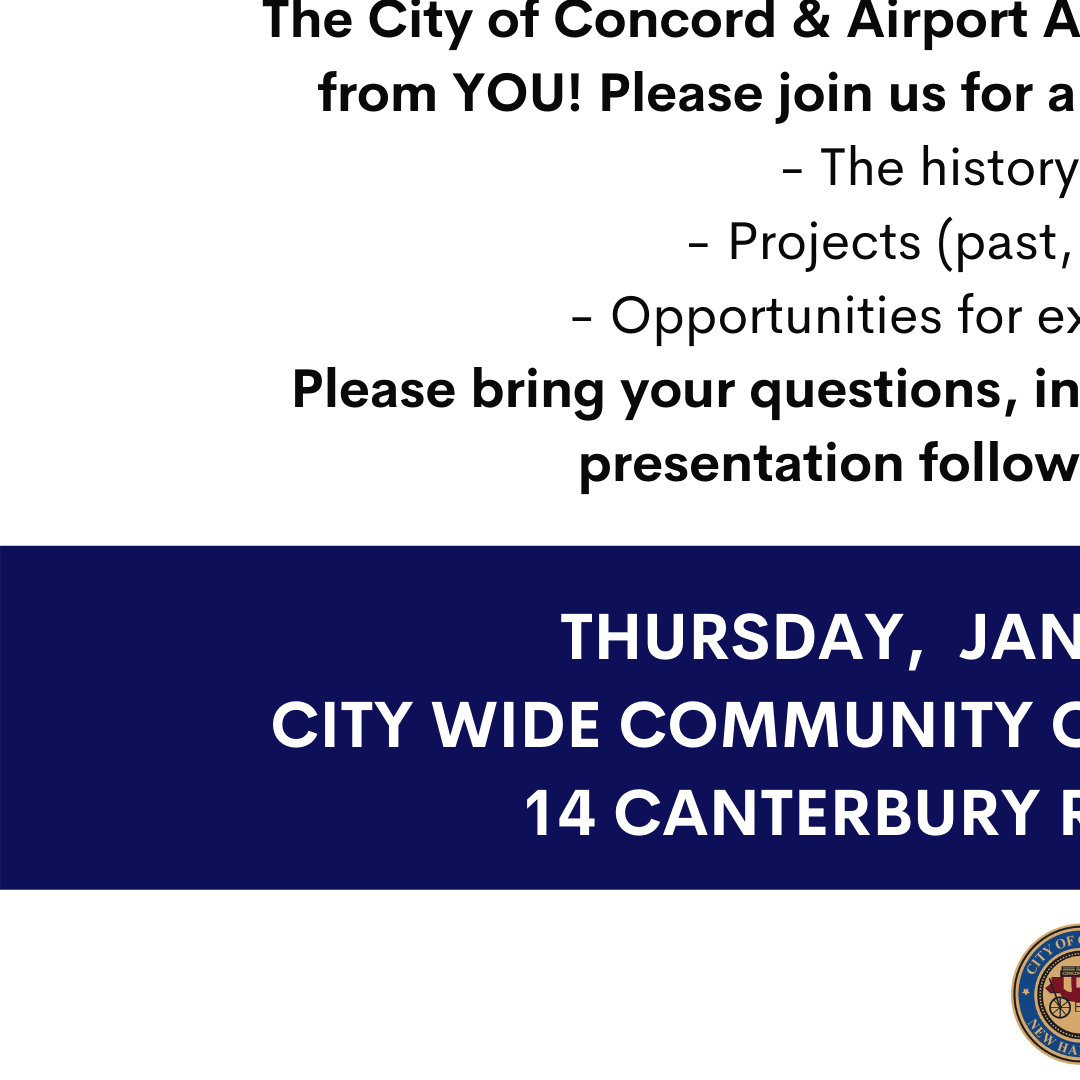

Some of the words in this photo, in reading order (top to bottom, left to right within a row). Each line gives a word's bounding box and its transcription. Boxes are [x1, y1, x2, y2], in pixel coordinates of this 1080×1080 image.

[794, 0, 830, 38] &
[318, 71, 435, 112] from
[453, 73, 579, 112] YOU!
[602, 71, 762, 112] Please
[776, 72, 870, 124] join
[891, 84, 945, 112] us
[961, 71, 1033, 112] for
[821, 145, 903, 186] The
[924, 145, 1079, 198] history
[732, 221, 920, 272] Projects
[939, 217, 1070, 272] (past,
[613, 295, 941, 346] Opportunities
[958, 293, 1022, 334] for
[295, 367, 455, 408] Please
[474, 367, 603, 421] bring
[621, 380, 735, 420] your
[751, 368, 1016, 420] questions,
[581, 442, 901, 494] presentation
[561, 613, 922, 671] THURSDAY,
[273, 701, 413, 748] CITY
[432, 702, 598, 747] WIDE
[621, 701, 1033, 748] COMMUNITY
[527, 790, 595, 835] 14
[616, 789, 1040, 836] CANTERBURY
[1026, 943, 1053, 975] CITY
[1055, 935, 1074, 949] OF
[1027, 1018, 1057, 1046] NEW
